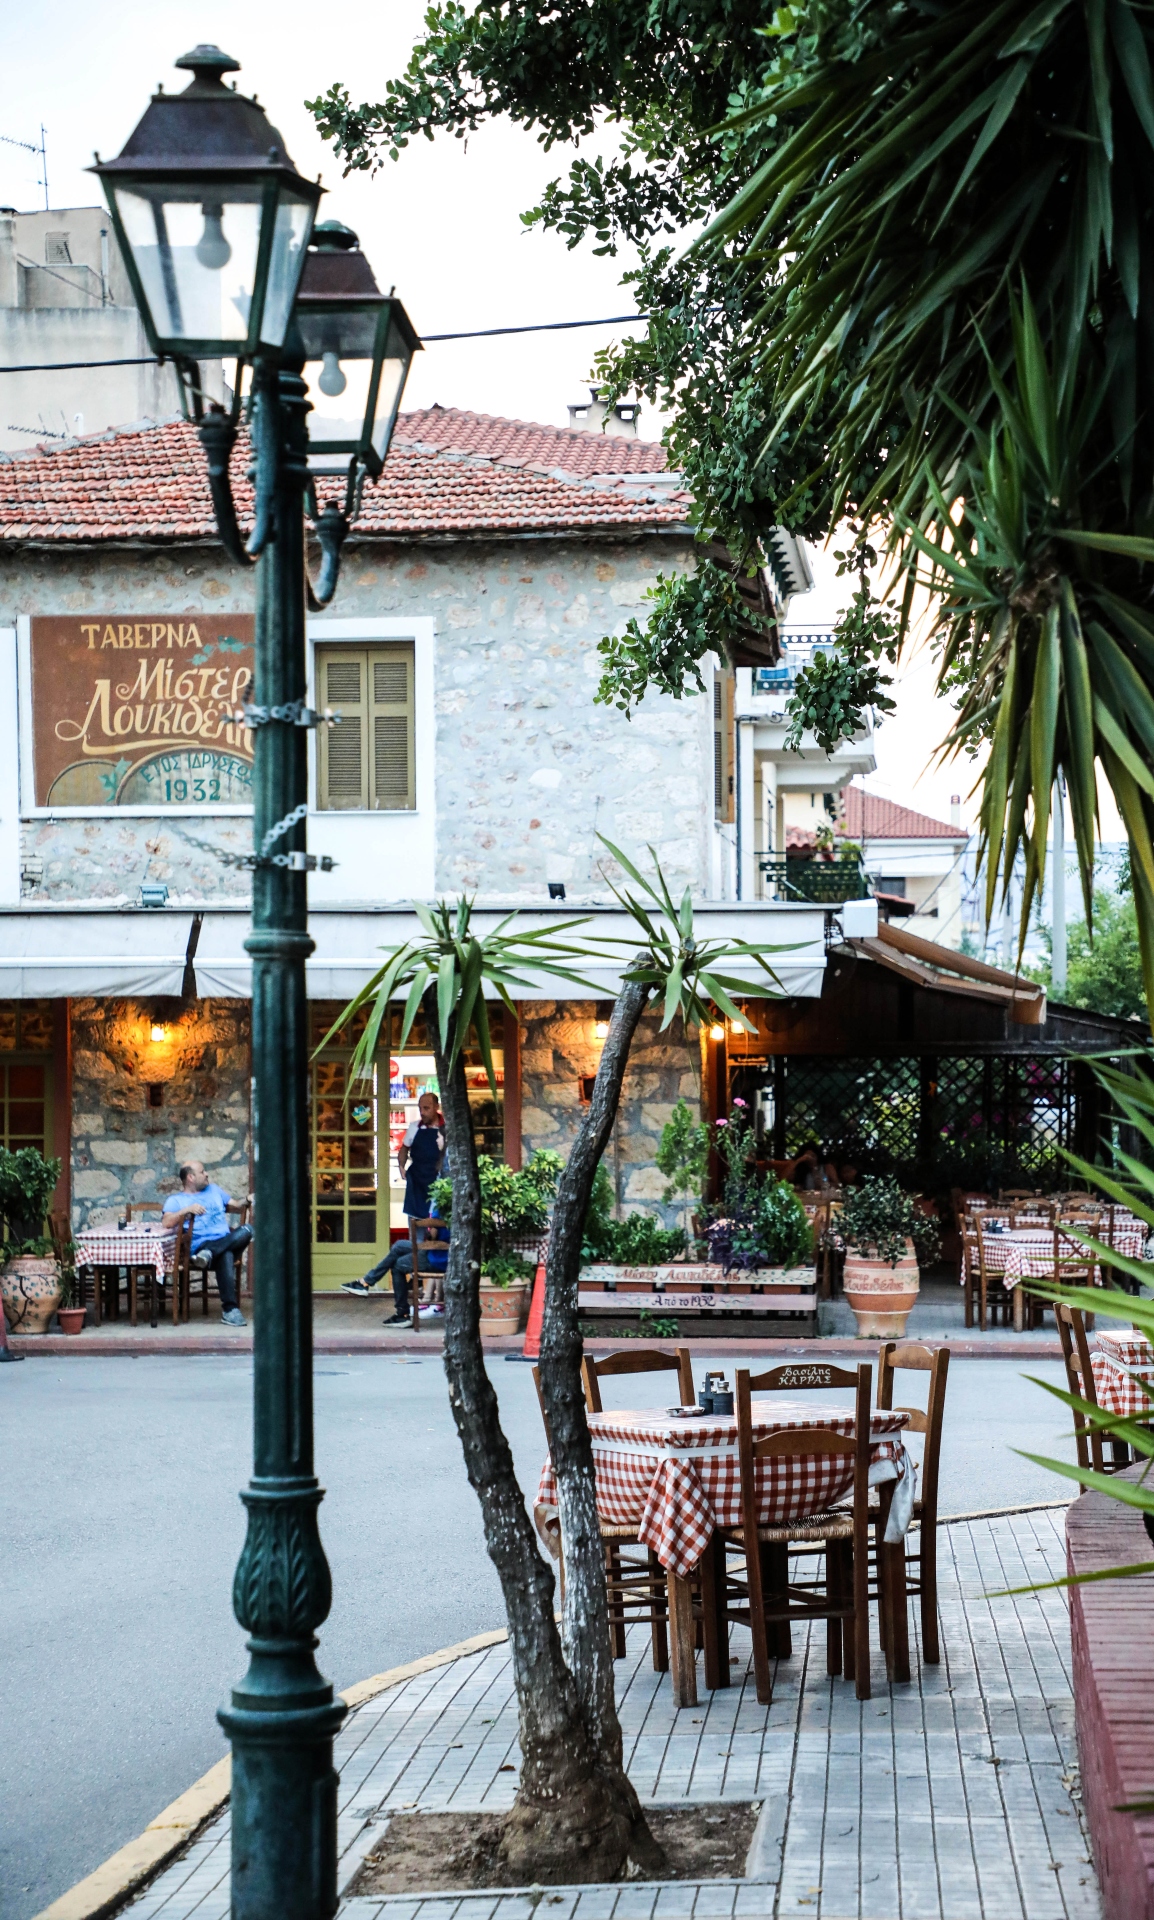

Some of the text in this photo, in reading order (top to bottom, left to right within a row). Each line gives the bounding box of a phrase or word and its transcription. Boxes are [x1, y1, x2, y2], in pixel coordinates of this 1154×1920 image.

[81, 623, 202, 649] ΤΑΒΕΡΝΑ
[55, 679, 255, 754] Λουκιδέλη
[140, 754, 182, 783] ΕΤΟΣ
[165, 779, 221, 802] 1932
[691, 1295, 716, 1307] 1932
[778, 1375, 832, 1386] ΚΑΡΡΑΣ
[781, 1366, 831, 1377] Βασίλης
